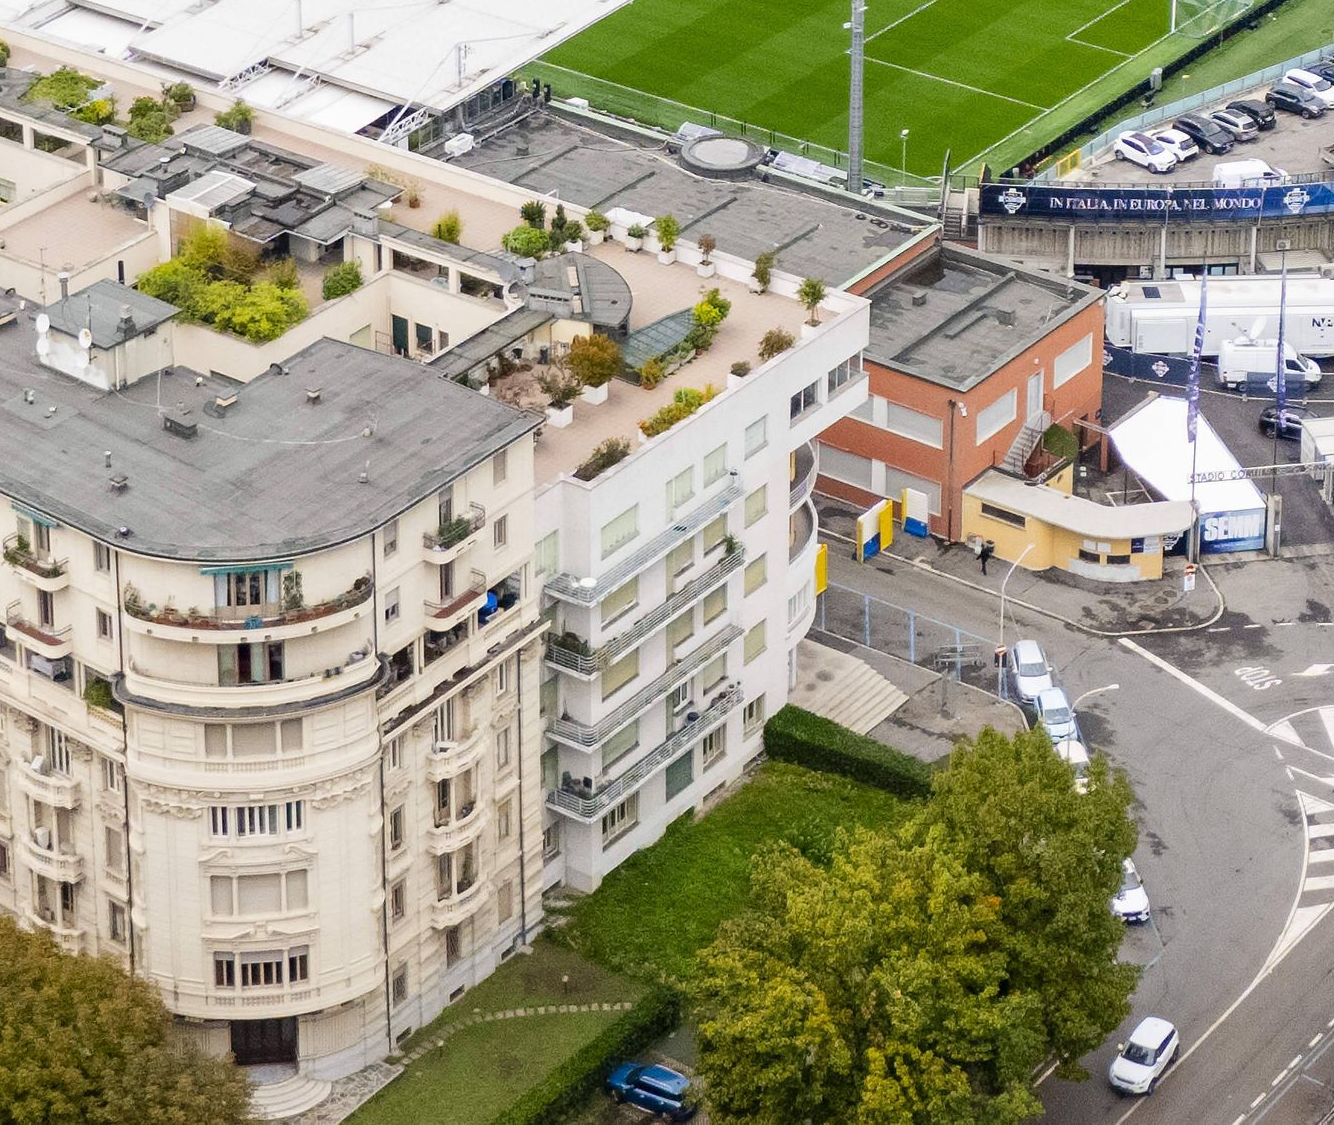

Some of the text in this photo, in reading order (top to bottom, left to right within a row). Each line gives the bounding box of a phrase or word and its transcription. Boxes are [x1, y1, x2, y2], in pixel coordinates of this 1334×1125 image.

[1049, 197, 1064, 209] IN
[1113, 198, 1128, 210] IN
[1214, 197, 1261, 209] MONDO
[1234, 666, 1283, 690] STOP
